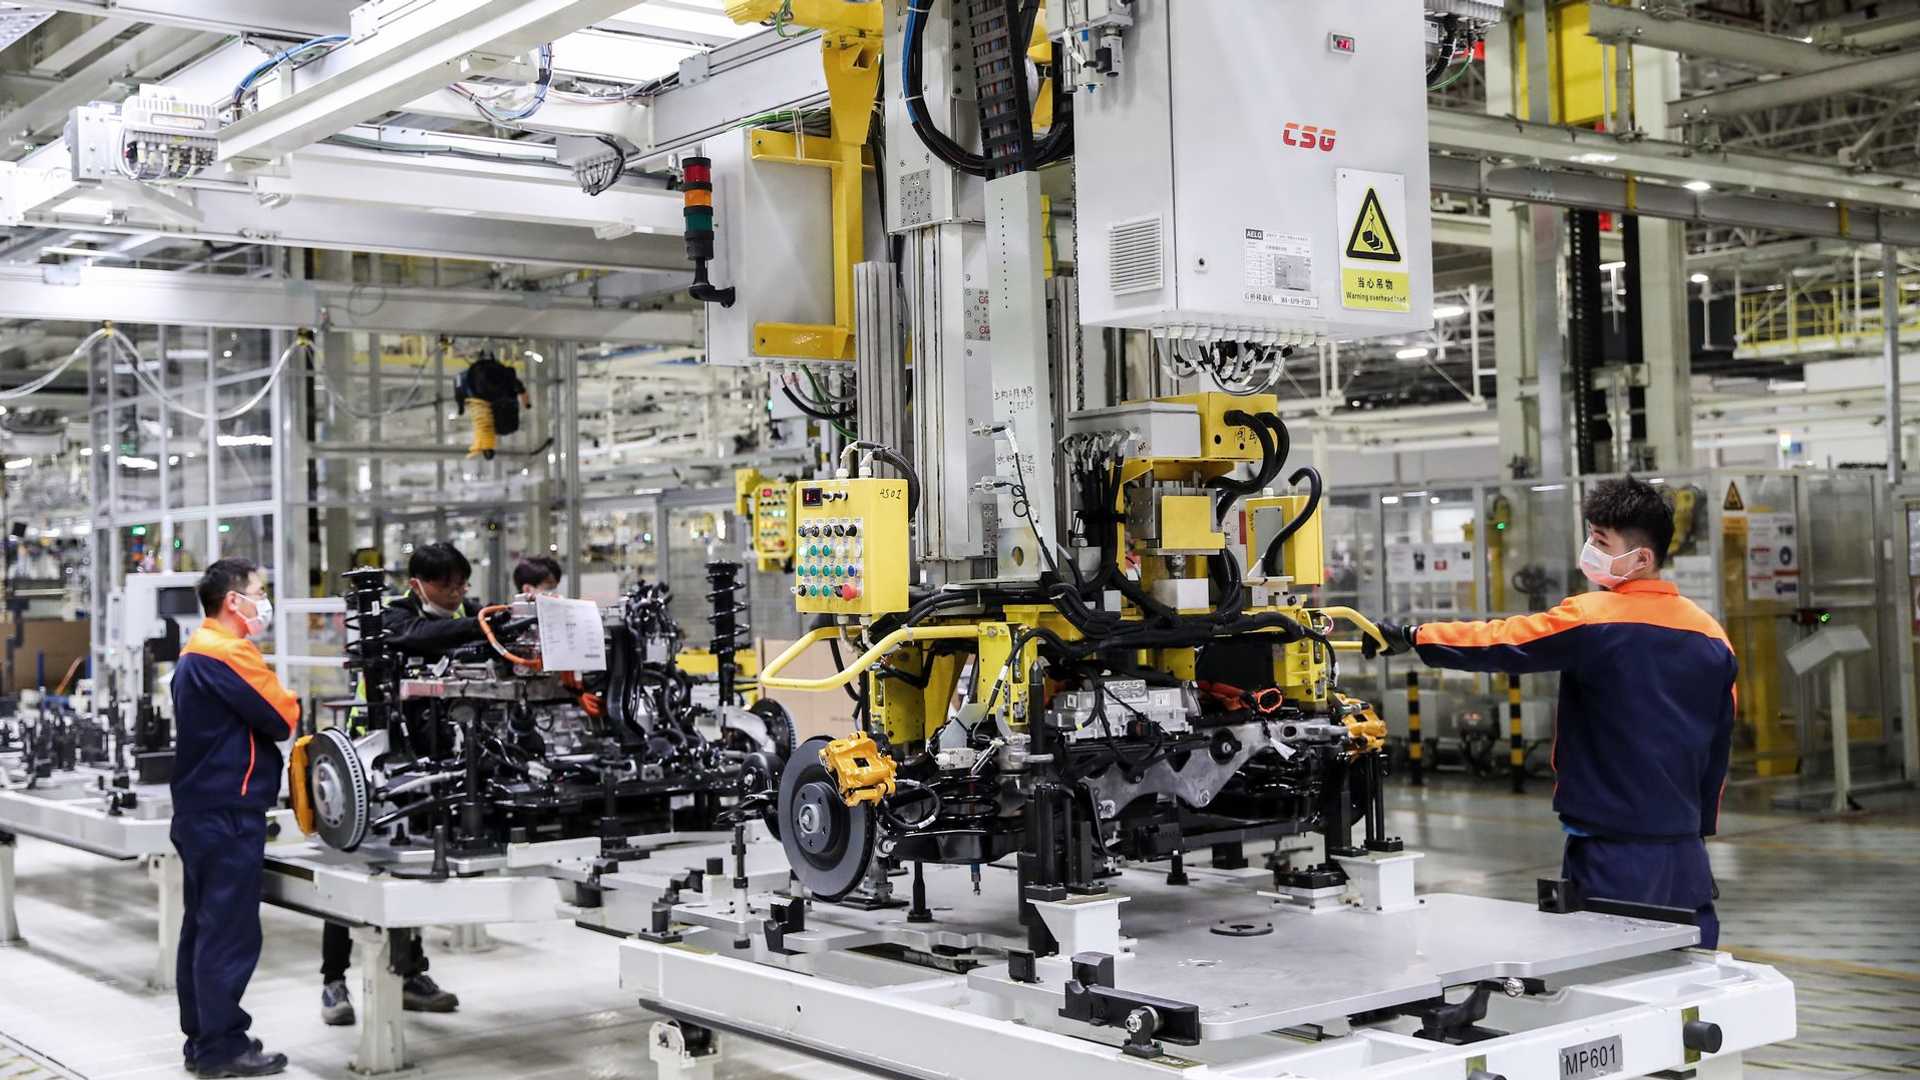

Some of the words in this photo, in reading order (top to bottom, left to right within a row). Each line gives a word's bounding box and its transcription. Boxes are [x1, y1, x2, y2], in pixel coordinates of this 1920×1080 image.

[1283, 122, 1336, 152] CSG
[1357, 276, 1393, 290] 当心吊物
[1345, 291, 1369, 302] Warning
[1565, 1043, 1616, 1076] MP601
